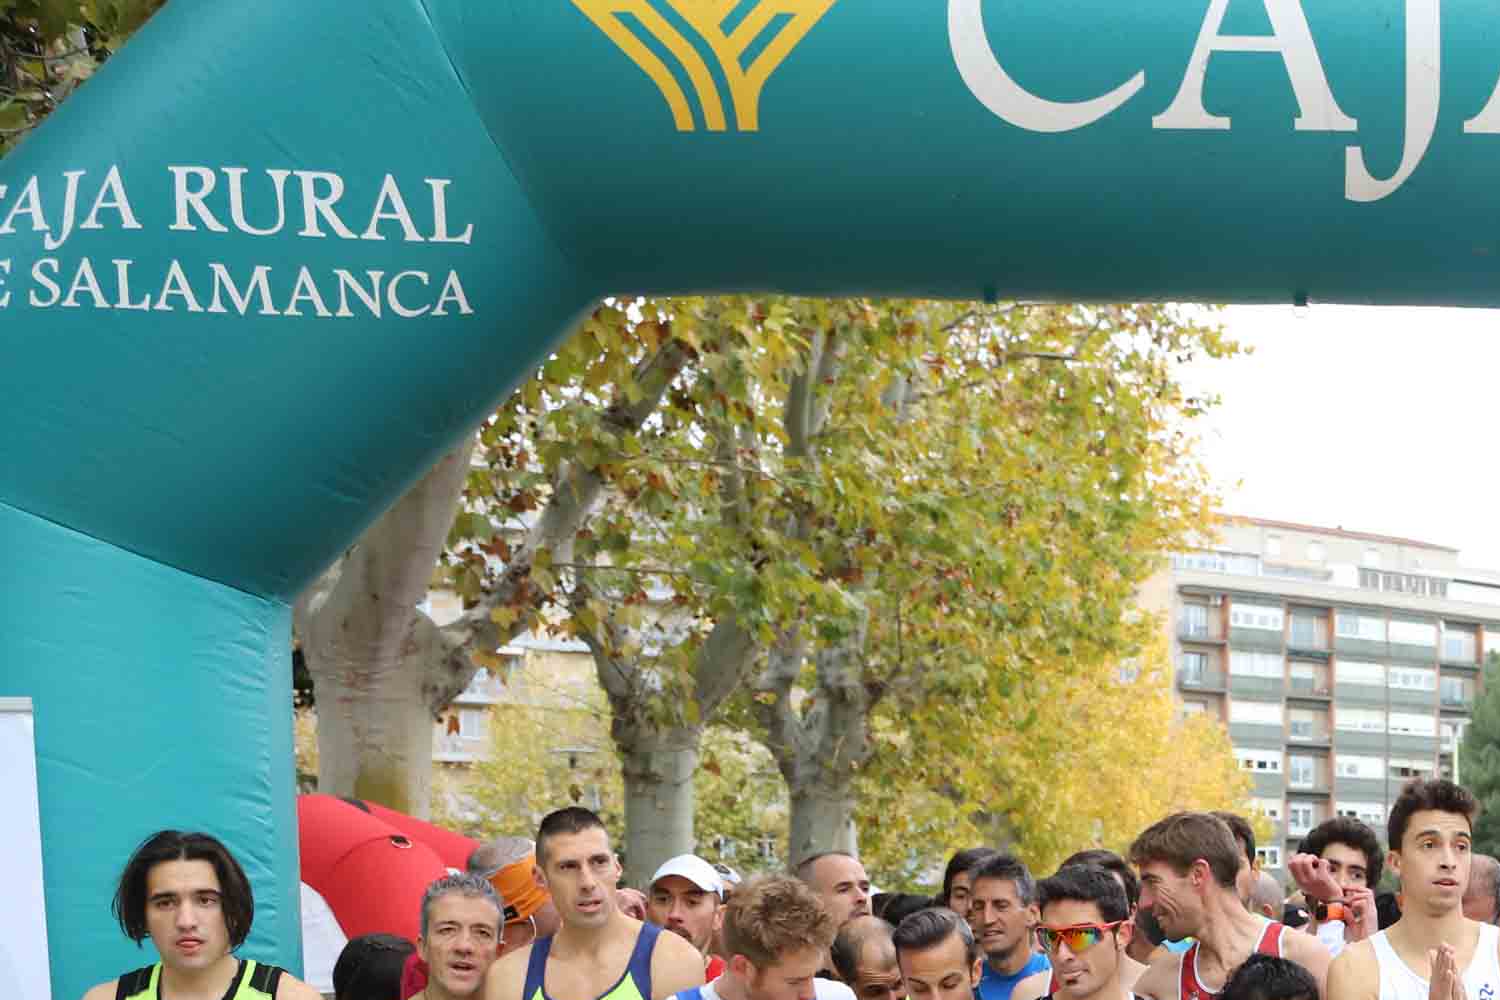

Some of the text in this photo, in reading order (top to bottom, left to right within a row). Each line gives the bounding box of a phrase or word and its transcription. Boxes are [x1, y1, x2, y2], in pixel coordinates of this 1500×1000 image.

[0, 165, 474, 250] AJA RURAL
[29, 258, 474, 319] SALAMANCA
